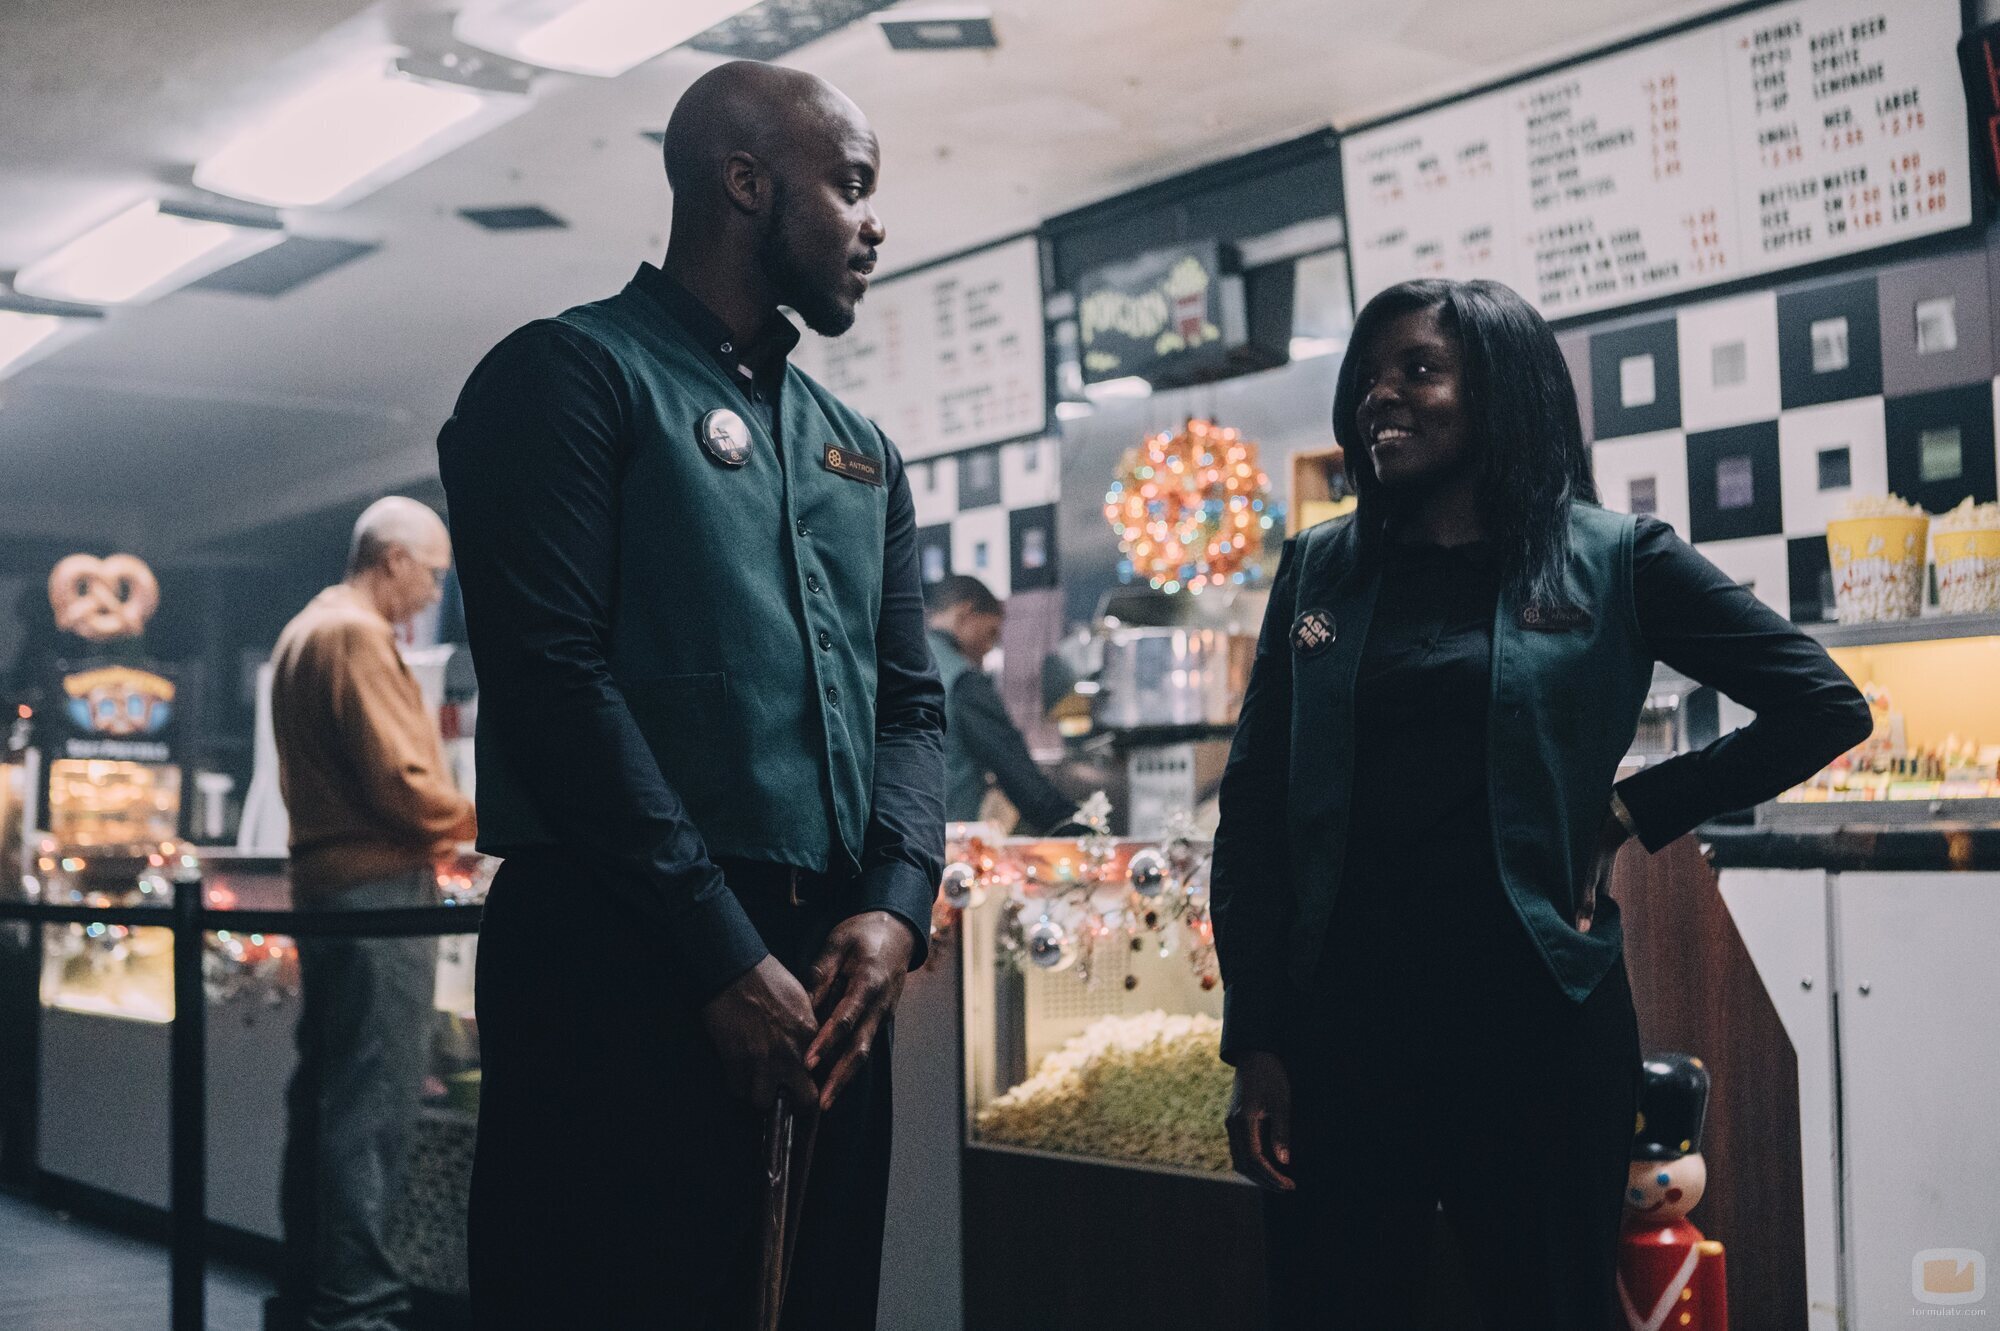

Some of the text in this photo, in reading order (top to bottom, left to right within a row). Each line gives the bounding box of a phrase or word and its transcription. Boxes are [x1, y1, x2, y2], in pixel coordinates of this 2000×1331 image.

[1809, 16, 1886, 52] ROOT BEER
[1812, 49, 1859, 75] SPRITE
[1813, 60, 1883, 100] LEMONADE
[1824, 167, 1867, 191] WATER
[1298, 625, 1318, 648] ME
[1303, 615, 1331, 642] ASK
